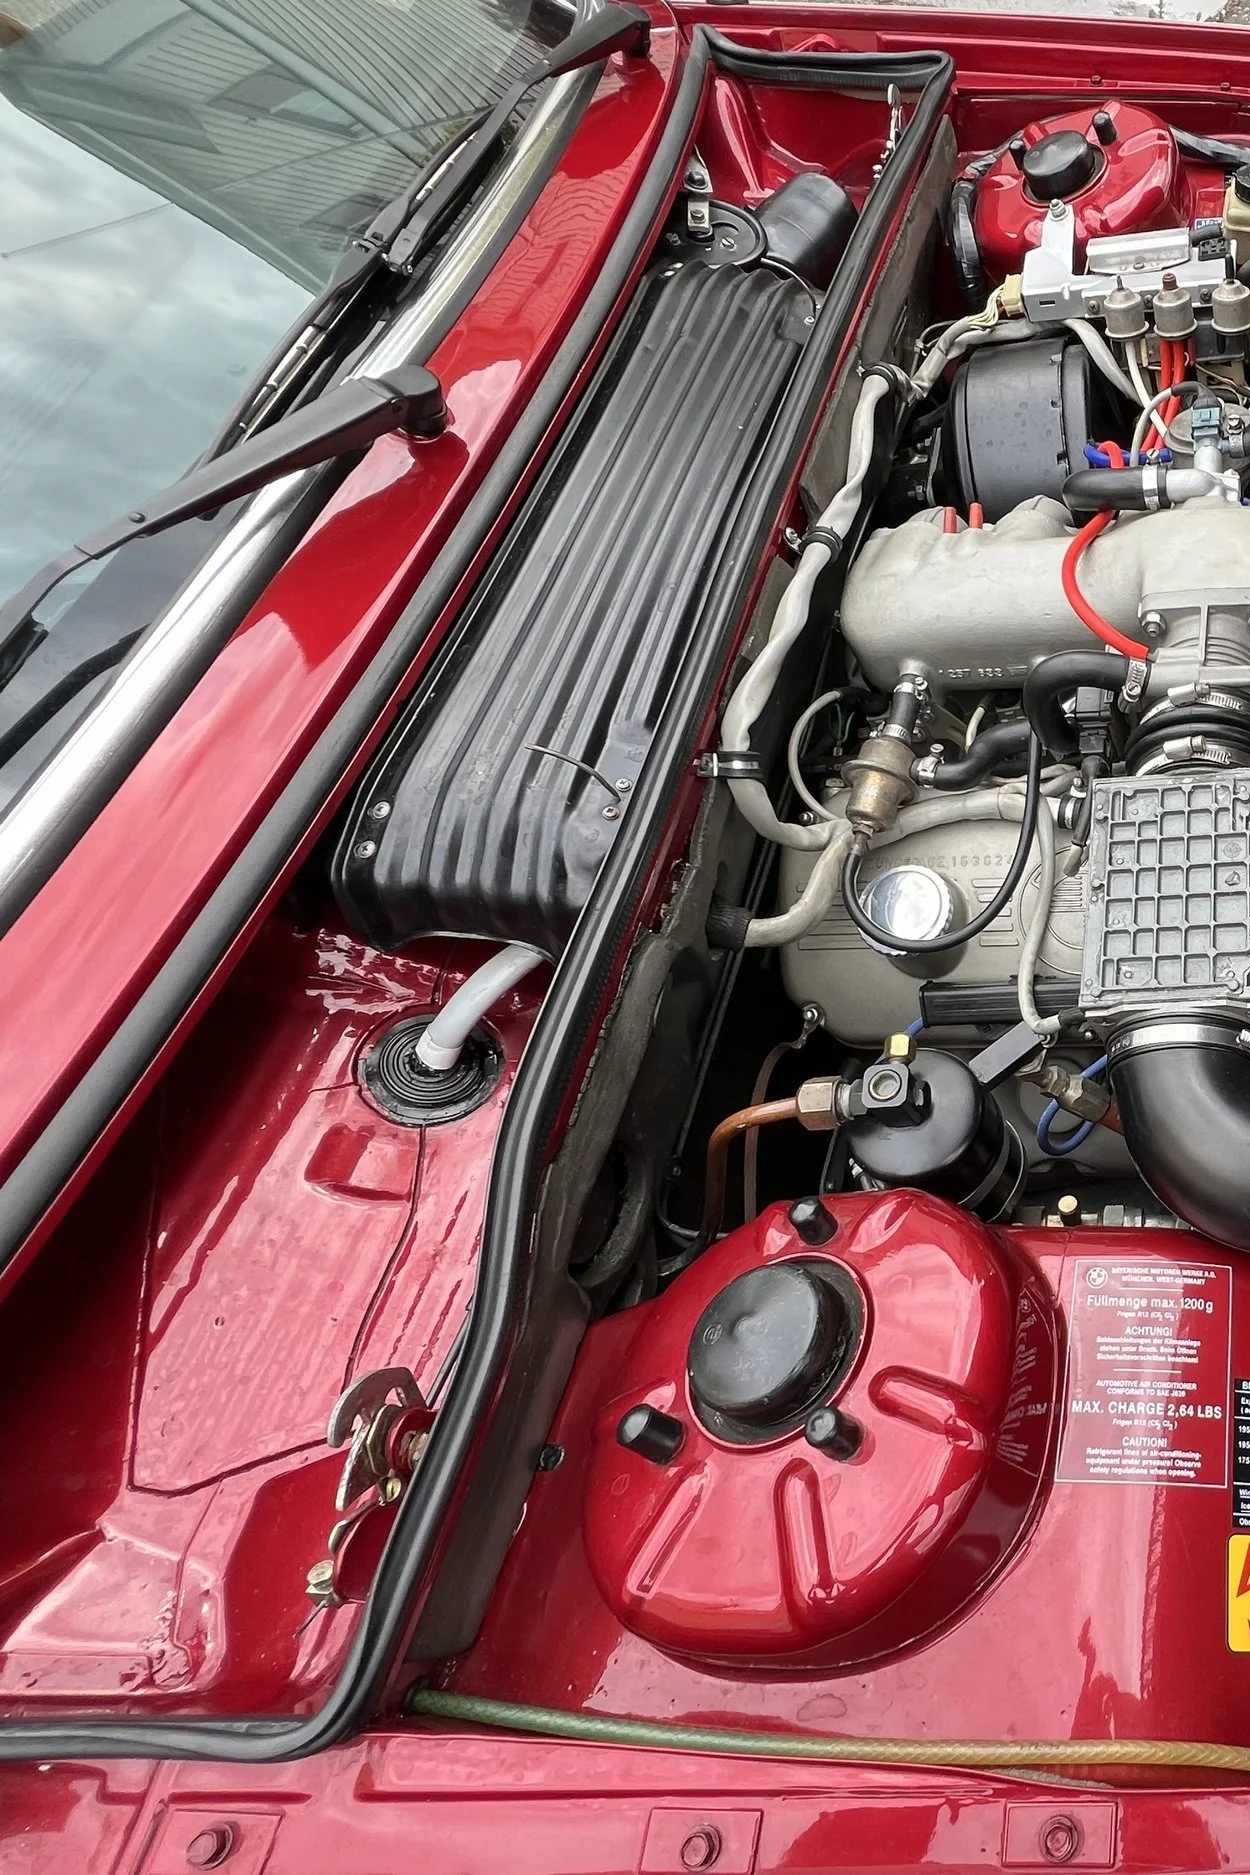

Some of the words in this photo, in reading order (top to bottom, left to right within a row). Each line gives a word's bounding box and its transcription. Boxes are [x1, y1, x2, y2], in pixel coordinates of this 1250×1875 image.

[1182, 1269, 1203, 1277] WERKE
[1087, 1294, 1148, 1310] Füllmenge
[1151, 1297, 1178, 1308] max.
[1180, 1298, 1205, 1310] 1200
[1206, 1301, 1214, 1313] g
[1125, 1325, 1173, 1336] ACHTUNG!
[1159, 1346, 1176, 1354] Beim
[1096, 1379, 1138, 1388] AUTOMOTIVE
[1152, 1381, 1197, 1390] CONDITIONER
[1107, 1387, 1144, 1396] CONFORMS
[1156, 1389, 1170, 1397] SAE
[1071, 1400, 1104, 1414] MAX.
[1108, 1401, 1164, 1415] CHARGE
[1167, 1404, 1194, 1418] 2,64
[1197, 1405, 1222, 1419] LBS
[1112, 1418, 1133, 1427] Frigen
[1122, 1436, 1168, 1447] CAUTION!
[1086, 1447, 1122, 1457] Refrigerant
[1123, 1448, 1140, 1456] lines
[1141, 1448, 1148, 1456] of
[1085, 1457, 1120, 1466] equipment
[1121, 1457, 1140, 1465] under
[1141, 1458, 1173, 1467] pressure!
[1174, 1459, 1202, 1468] Observe
[1237, 1456, 1250, 1465] 175
[1089, 1465, 1110, 1475] safety
[1110, 1466, 1148, 1475] regulations
[1148, 1467, 1167, 1476] when
[1241, 1502, 1250, 1510] Ice
